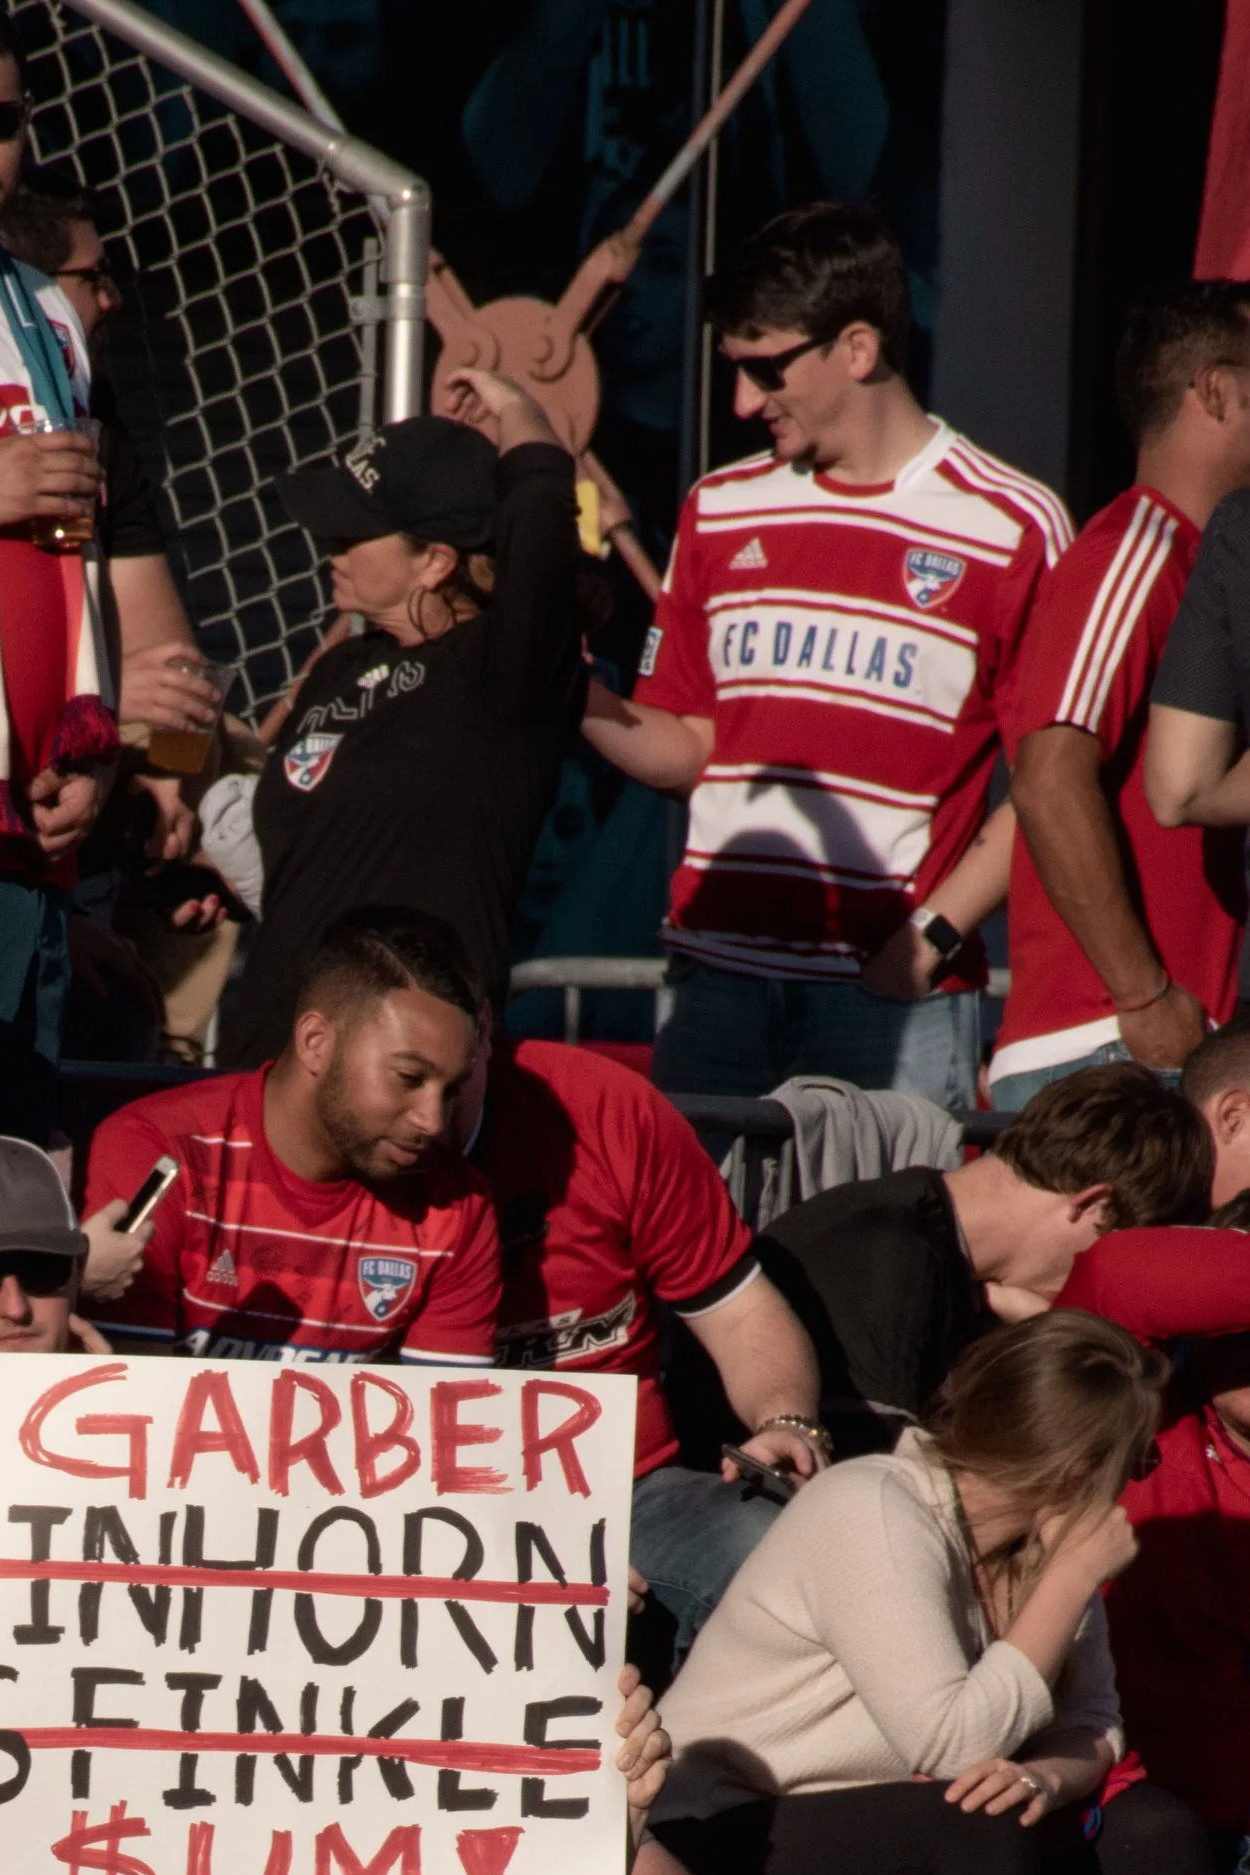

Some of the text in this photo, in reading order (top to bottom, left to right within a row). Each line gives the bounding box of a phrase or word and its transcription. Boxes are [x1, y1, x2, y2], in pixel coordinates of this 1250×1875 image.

[925, 552, 961, 576] DALLAS
[723, 619, 760, 667] FC
[772, 620, 919, 690] DALLAS
[362, 1260, 412, 1281] FC DALLAS
[18, 1363, 602, 1500] GARBER
[68, 1666, 604, 1820] FINKLE
